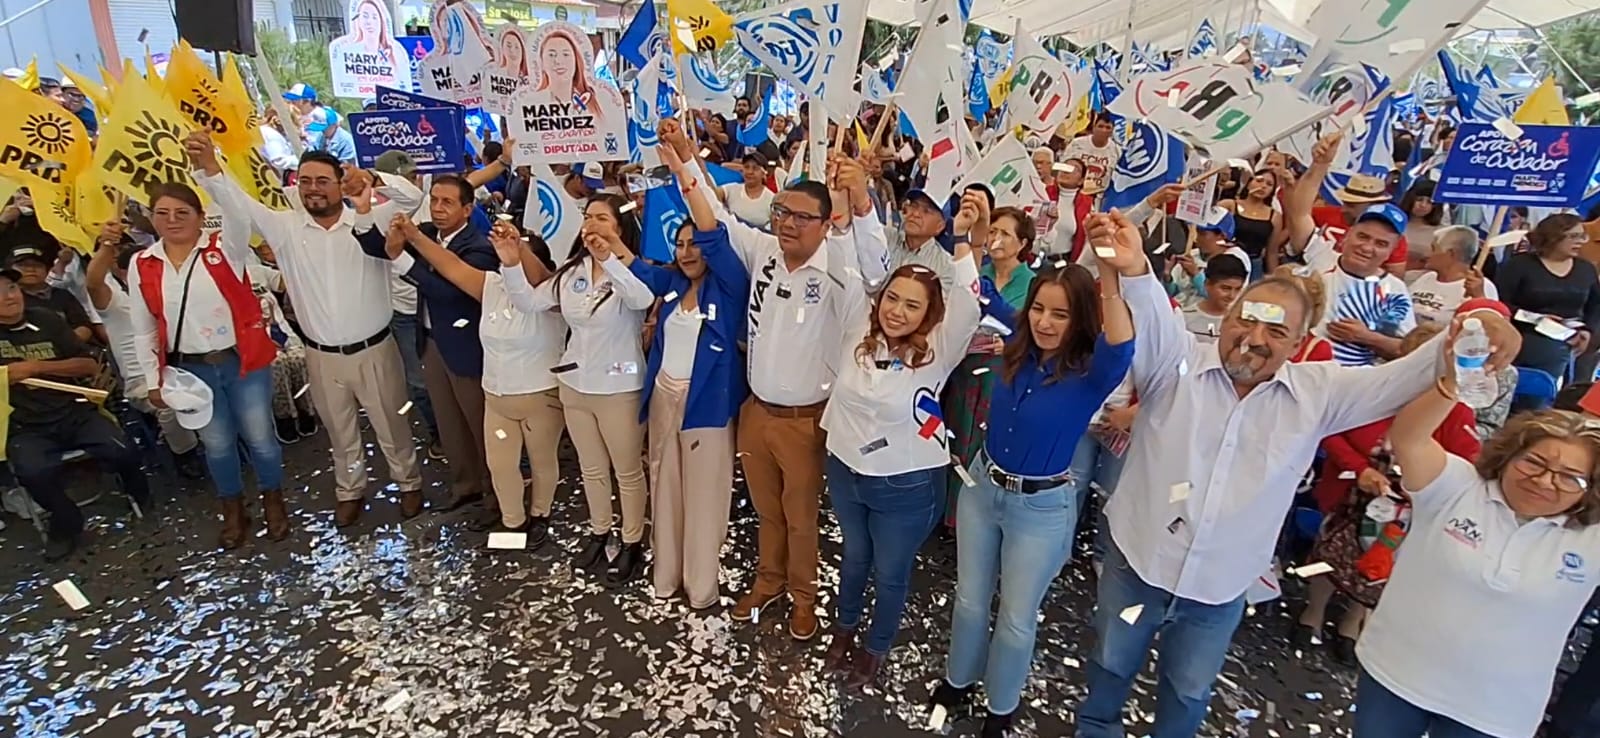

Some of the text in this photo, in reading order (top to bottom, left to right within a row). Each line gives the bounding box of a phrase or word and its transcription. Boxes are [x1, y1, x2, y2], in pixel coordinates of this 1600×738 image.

[490, 75, 518, 87] MARY
[1010, 64, 1062, 122] PRI
[180, 99, 228, 134] PRD
[522, 103, 571, 118] MARY
[544, 144, 598, 154] DIPUTADA
[1470, 152, 1487, 164] de
[749, 256, 777, 328] IVAN
